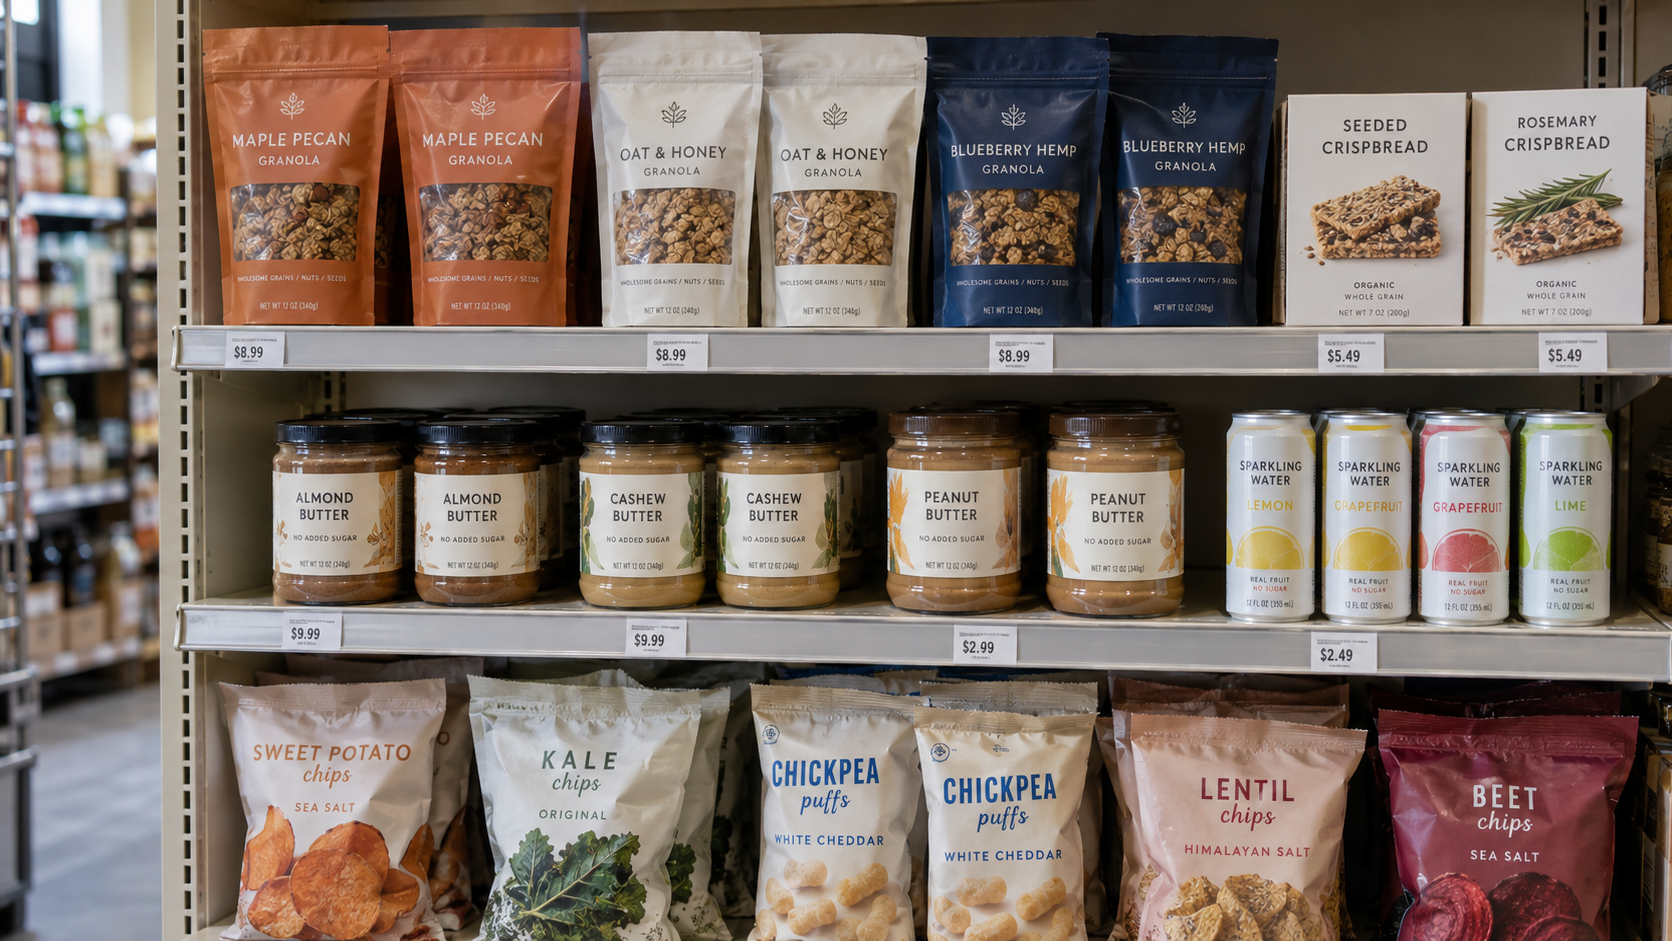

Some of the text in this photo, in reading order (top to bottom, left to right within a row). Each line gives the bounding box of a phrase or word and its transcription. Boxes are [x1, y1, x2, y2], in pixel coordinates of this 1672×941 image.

[1343, 119, 1407, 132] SEEDED
[1518, 115, 1597, 129] ROSEMARY
[232, 132, 351, 148] MAPLE PECAN
[423, 132, 543, 148] MAPLE PECAN
[1504, 136, 1611, 152] CRISPBREAD
[951, 144, 1077, 158] BLUEBERRY HEMP
[1123, 140, 1246, 155] BLUEBERRY HEMP
[1322, 140, 1428, 155] CRISPBREAD
[620, 146, 727, 162] OAT & HONEY
[780, 148, 888, 162] OAT & HONEY
[258, 155, 320, 166] GRANOLA
[448, 155, 513, 166] GRANOLA
[1155, 161, 1217, 172] GRANOLA
[643, 166, 700, 176] GRANOLA
[804, 168, 862, 178] GRANOLA
[982, 165, 1045, 175] GRANOLA
[1353, 281, 1395, 289] ORGANIC
[1536, 280, 1577, 288] ORGANIC
[234, 346, 263, 359] $8.99
[656, 348, 686, 361] $8.99
[999, 349, 1030, 363] $8.99
[1327, 349, 1361, 363] $5.49
[1548, 348, 1582, 363] $5.49
[1240, 460, 1302, 471] SPARKLING
[1338, 461, 1401, 472] SPARKLING
[1437, 462, 1500, 473] SPARKLING
[1539, 460, 1603, 471] SPARKLING
[1251, 475, 1291, 486] WATER
[1350, 476, 1390, 486] WATER
[1450, 477, 1490, 487] WATER
[1552, 475, 1592, 486] WATER
[296, 492, 354, 504] ALMOND
[443, 493, 502, 505] ALMOND
[610, 493, 666, 505] CASHEW
[746, 492, 802, 504] CASHEW
[924, 491, 979, 503] PEANUT
[1090, 493, 1146, 505] PEANUT
[1247, 500, 1293, 511] LEMON
[1334, 500, 1403, 512] GRAPEFRUIT
[1433, 502, 1503, 513] GRAPEFRUIT
[1555, 500, 1586, 511] LIME
[299, 509, 349, 521] BUTTER
[447, 510, 498, 522] BUTTER
[613, 510, 663, 522] BUTTER
[749, 510, 799, 521] BUTTER
[926, 509, 978, 521] BUTTER
[1092, 511, 1144, 523] BUTTER
[480, 535, 505, 543] SUGAR
[619, 536, 644, 544] ADDED
[932, 535, 957, 543] ADDED
[960, 535, 985, 543] SUGAR
[1127, 537, 1152, 545] SUGAR
[1349, 577, 1366, 585] REAL
[291, 627, 320, 641] $9.99
[634, 633, 665, 647] $9.99
[962, 640, 994, 654] $2.99
[1320, 648, 1353, 662] $2.49
[253, 744, 411, 761] SWEET POTATO
[541, 750, 618, 770] KALE
[303, 764, 353, 789] chips
[772, 757, 880, 788] CHICKPEA
[552, 771, 601, 798] chips
[943, 773, 1057, 805] CHICKPEA
[1200, 777, 1295, 802] LENTIL
[800, 789, 851, 815] puffs
[1472, 784, 1538, 810] BEET
[295, 802, 355, 813] SEA SALT
[539, 809, 607, 820] ORIGINAL
[977, 806, 1029, 833] puffs
[1220, 803, 1276, 832] chips
[1477, 810, 1533, 839] chips
[774, 834, 884, 846] WHITE CHEDDAR
[944, 849, 1063, 862] WHITE CHEDDAR
[1184, 844, 1311, 858] HIMALAYAN SALT
[1470, 850, 1540, 863] SEA SALT
